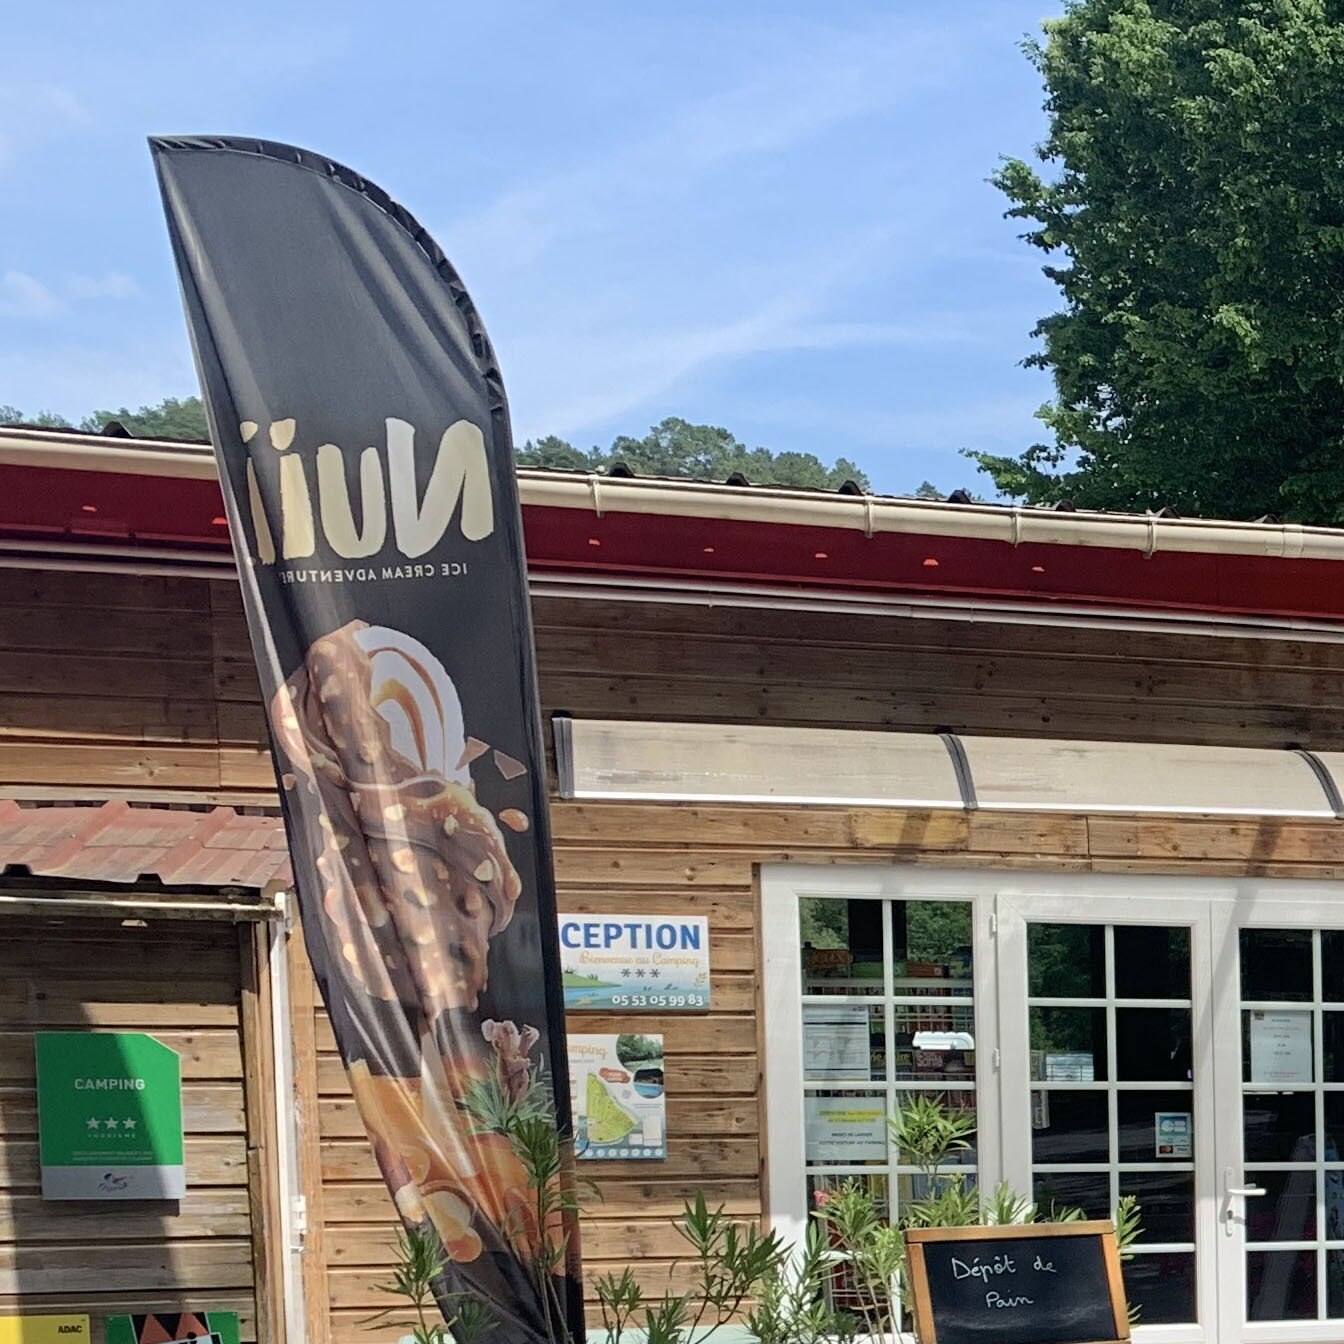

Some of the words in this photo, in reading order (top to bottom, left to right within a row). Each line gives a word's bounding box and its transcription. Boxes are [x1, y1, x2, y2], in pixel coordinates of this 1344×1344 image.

[561, 922, 701, 949] CEPTION
[612, 995, 628, 1006] 05
[631, 995, 647, 1006] 53
[650, 995, 667, 1006] 05
[669, 996, 685, 1007] 99
[687, 994, 704, 1007] 83
[74, 1078, 145, 1091] CAMPING
[951, 1254, 1016, 1283] Dépôt
[1034, 1255, 1056, 1273] de
[985, 1289, 1034, 1308] Pain
[57, 1325, 83, 1334] ADAC
